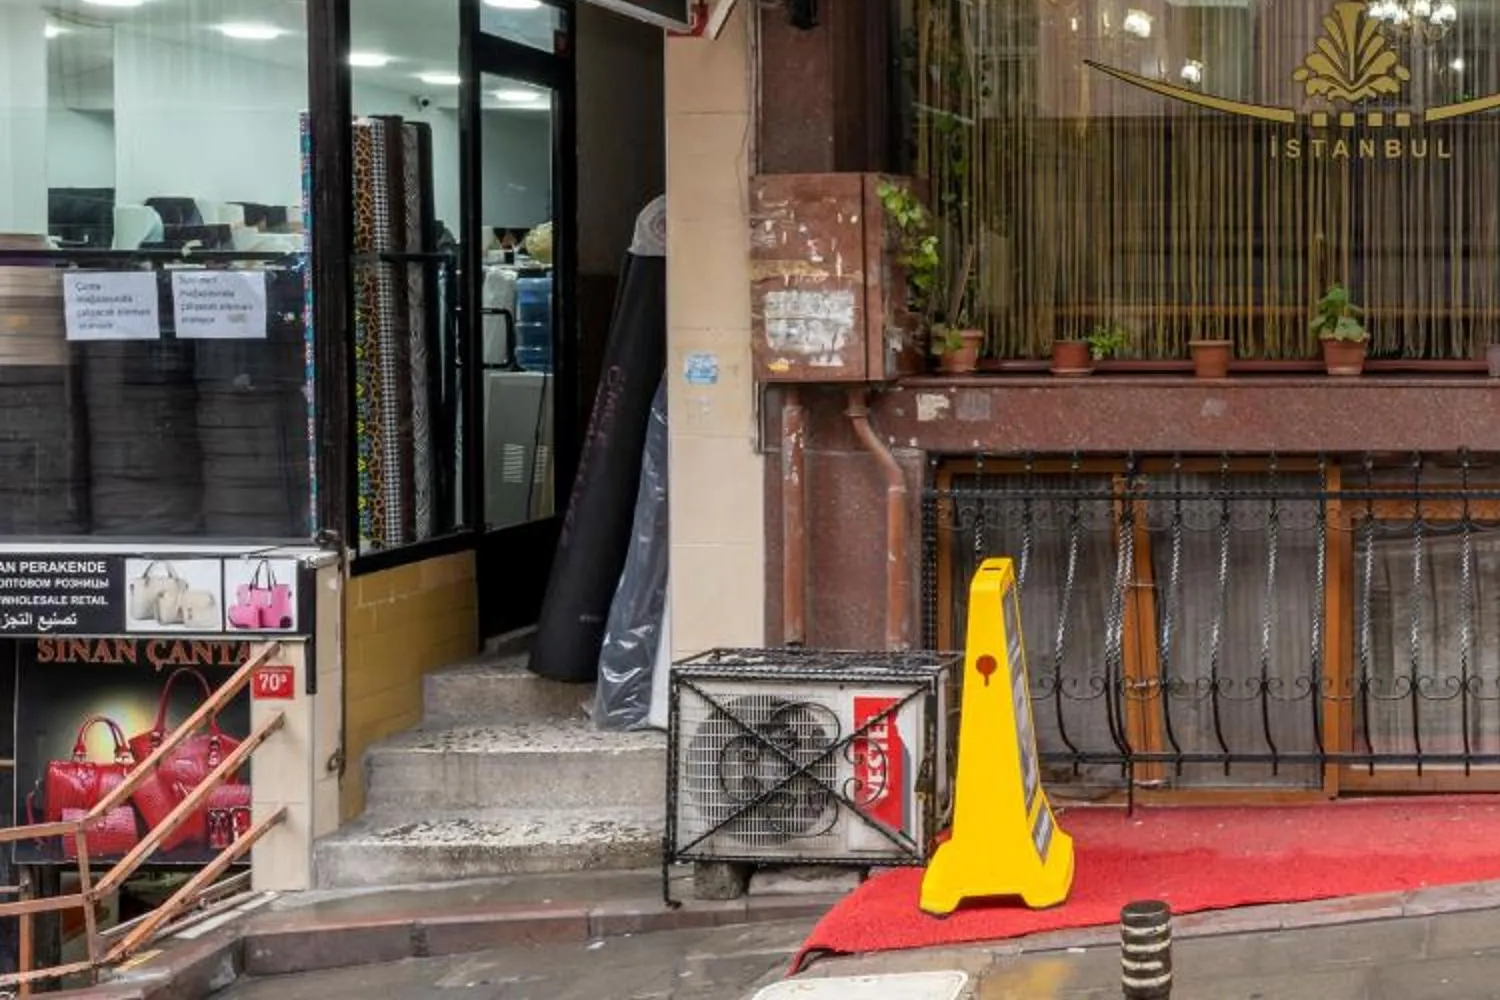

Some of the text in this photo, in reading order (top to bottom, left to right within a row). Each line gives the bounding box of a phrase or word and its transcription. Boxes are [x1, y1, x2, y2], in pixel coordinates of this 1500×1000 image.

[1270, 137, 1453, 159] İSTANBUL
[19, 561, 107, 573] PERAKENDE
[70, 595, 109, 605] RETAIL
